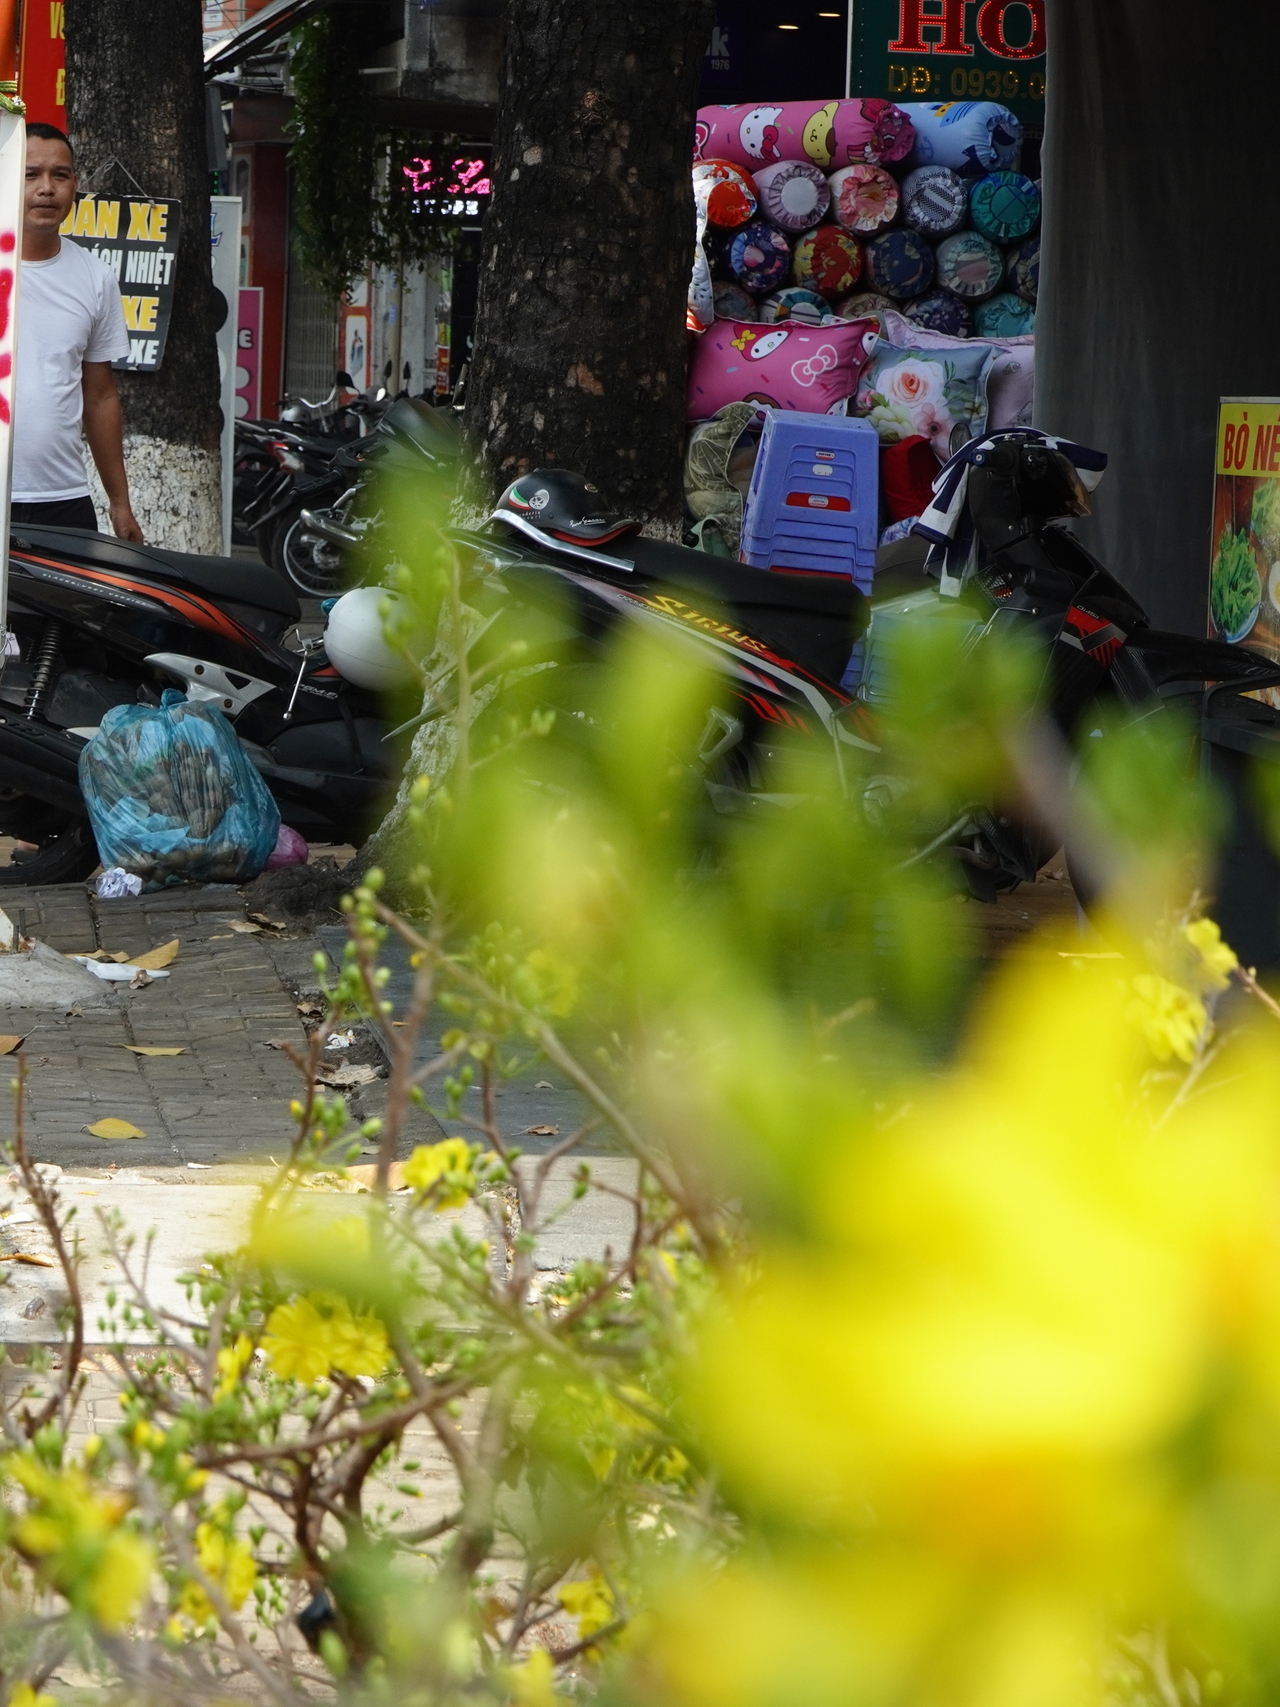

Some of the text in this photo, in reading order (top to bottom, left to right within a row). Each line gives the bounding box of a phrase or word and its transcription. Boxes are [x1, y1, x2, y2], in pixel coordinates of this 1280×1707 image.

[711, 59, 730, 70] 1976
[126, 202, 168, 242] XE
[82, 243, 175, 291] ÁCH NHIỆT
[126, 339, 160, 364] XE
[1223, 412, 1250, 471] BÒ
